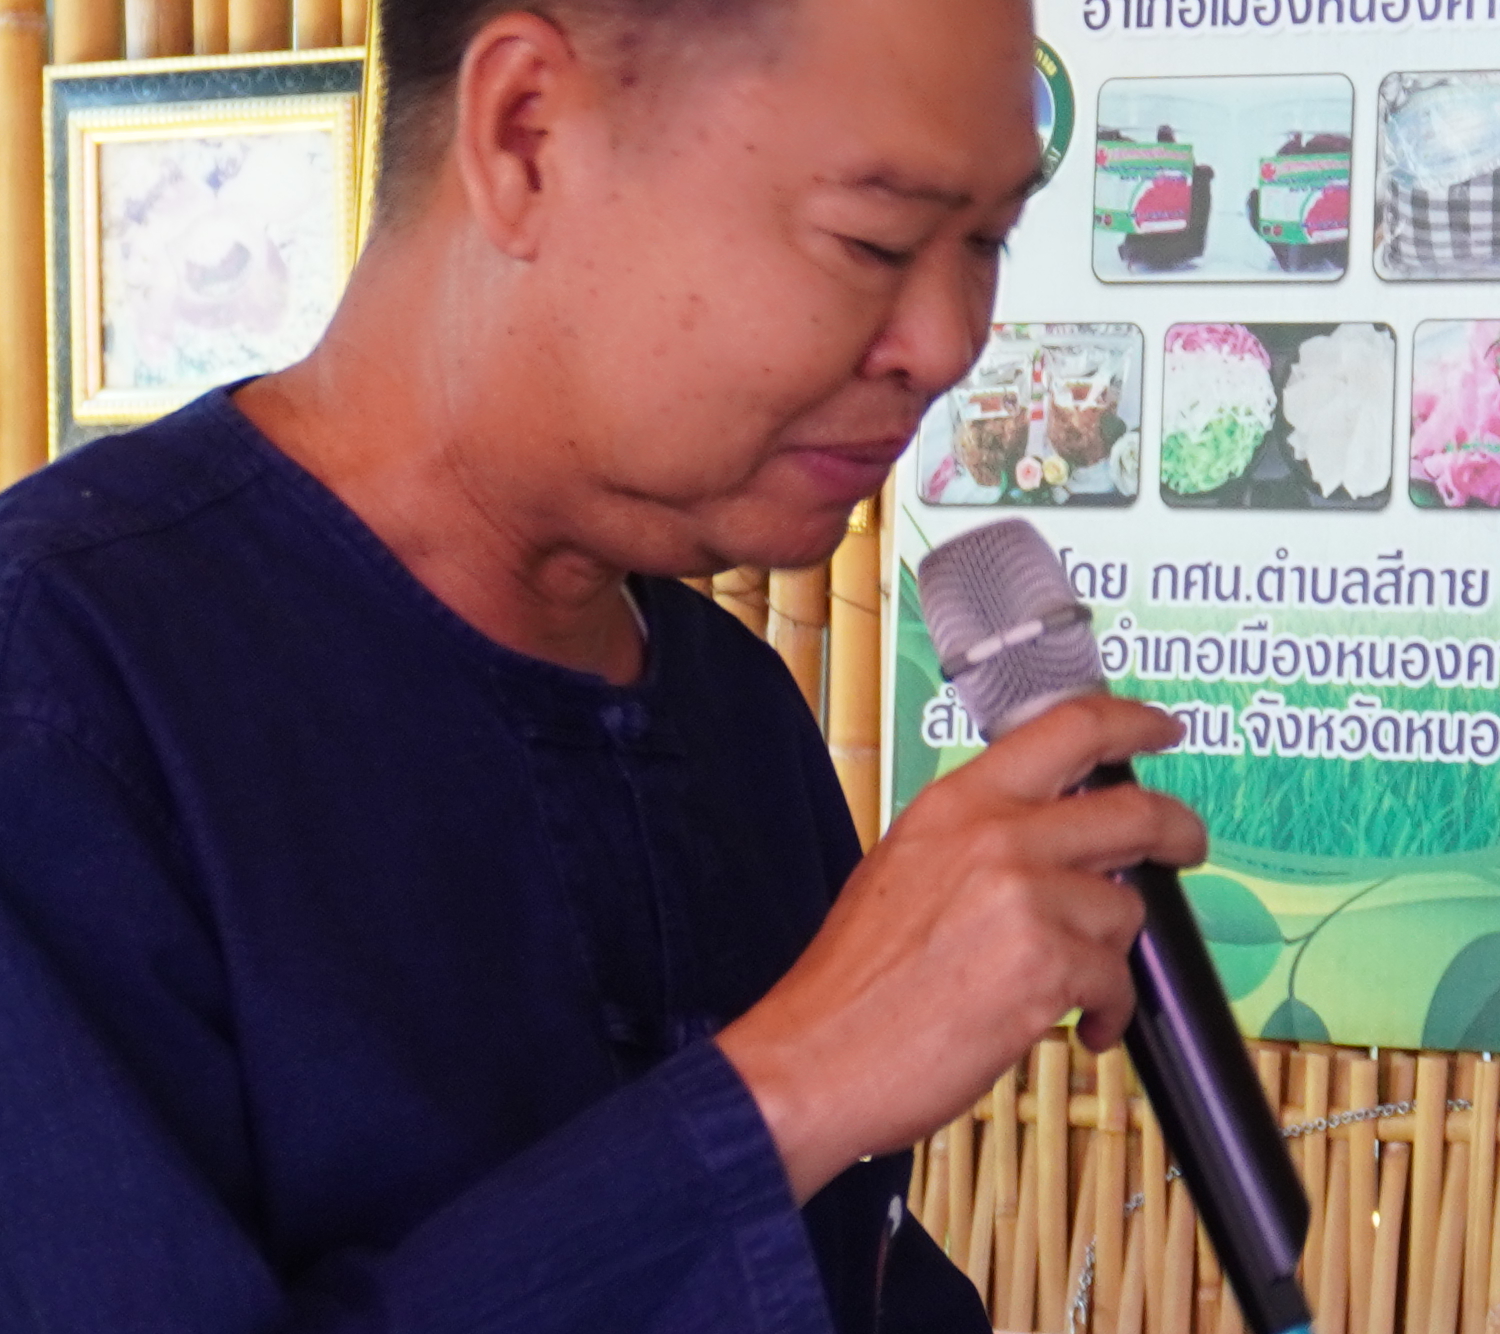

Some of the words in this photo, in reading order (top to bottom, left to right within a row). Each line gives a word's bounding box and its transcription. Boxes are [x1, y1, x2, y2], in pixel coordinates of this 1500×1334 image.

[1152, 548, 1489, 608] กศน.ตำบลสีกาย
